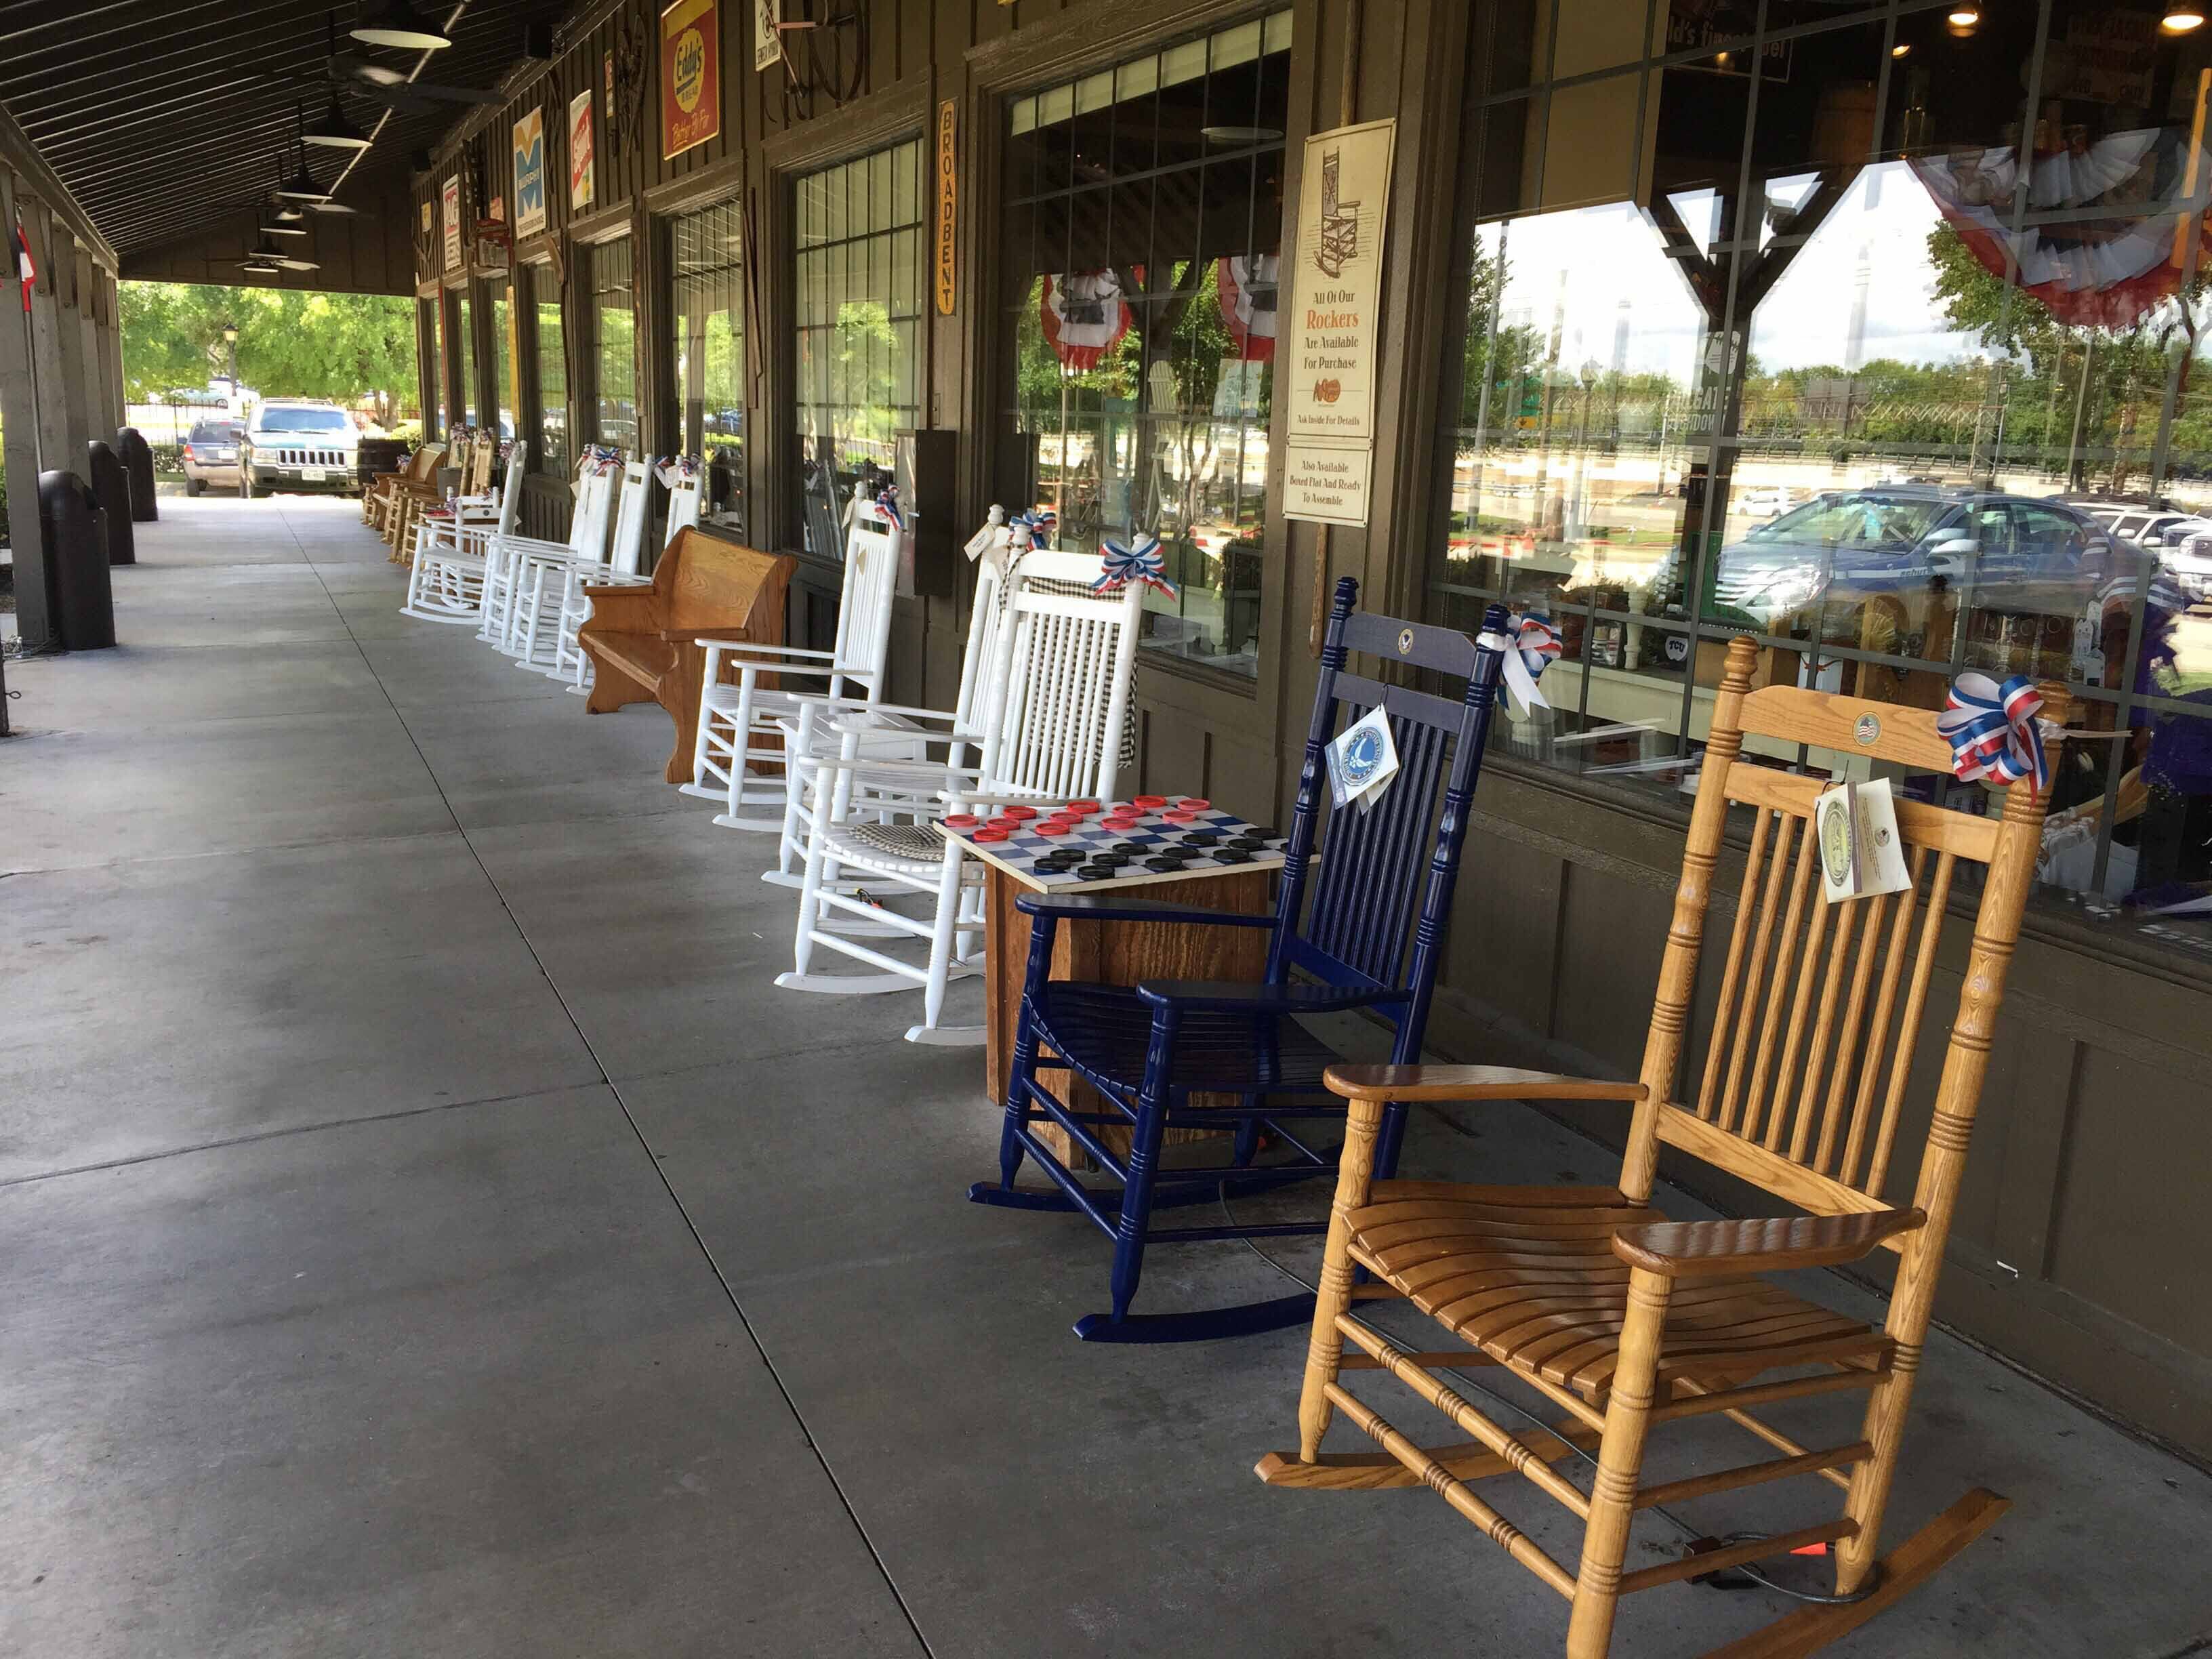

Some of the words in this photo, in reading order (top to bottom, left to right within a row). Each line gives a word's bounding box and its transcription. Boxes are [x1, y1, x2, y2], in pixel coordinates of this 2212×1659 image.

[676, 37, 702, 83] Eddy's
[942, 110, 953, 310] BROADBENT
[1313, 291, 1325, 304] All
[1326, 290, 1337, 304] Of
[1338, 289, 1355, 304] Our
[1307, 309, 1359, 330] Rockers
[1303, 336, 1318, 350] Are
[1319, 335, 1359, 349] Available
[1304, 356, 1317, 369] For
[1318, 356, 1357, 369] Purchase
[1297, 414, 1307, 424] Ask
[1308, 414, 1324, 425] Inside
[1325, 415, 1336, 426] For
[1337, 415, 1360, 426] Details
[1301, 461, 1315, 472] Also
[1316, 461, 1349, 474] Available
[1290, 475, 1308, 487] Boxed
[1309, 476, 1322, 488] Flat
[1322, 478, 1337, 489] And
[1338, 478, 1361, 491] Ready
[1303, 492, 1311, 504] To
[1311, 493, 1344, 506] Assemble
[1668, 639, 1686, 653] TCU
